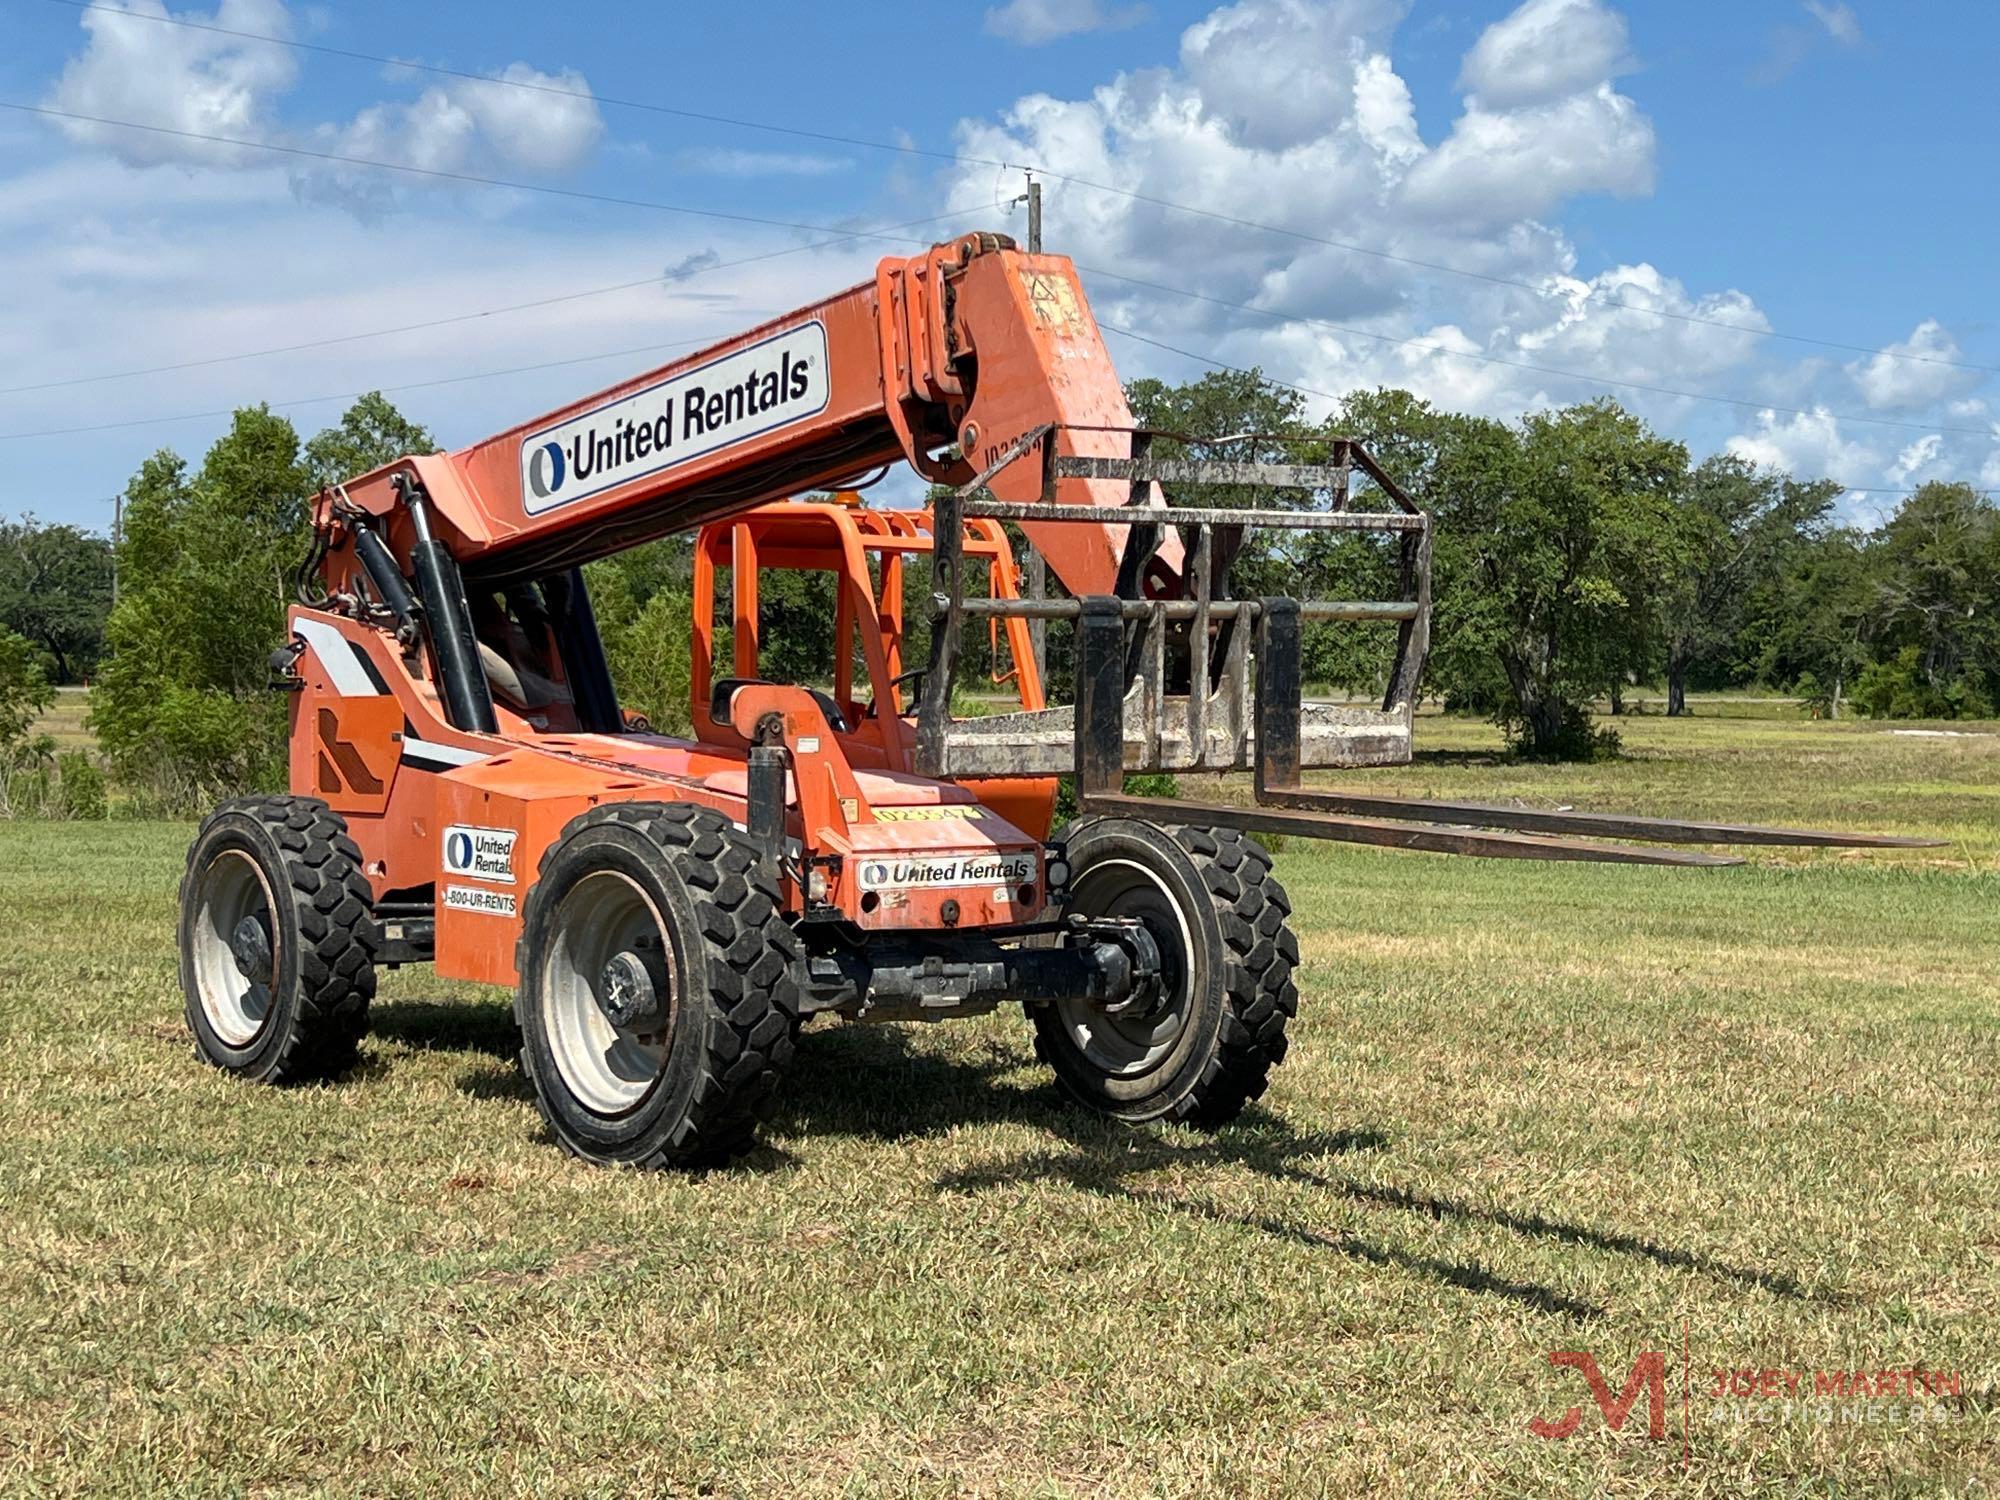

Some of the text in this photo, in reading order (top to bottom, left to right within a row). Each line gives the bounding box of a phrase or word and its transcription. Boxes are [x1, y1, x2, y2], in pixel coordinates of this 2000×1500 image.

[573, 397, 673, 480] United
[475, 836, 512, 855] United
[894, 859, 1029, 883] United Rentals
